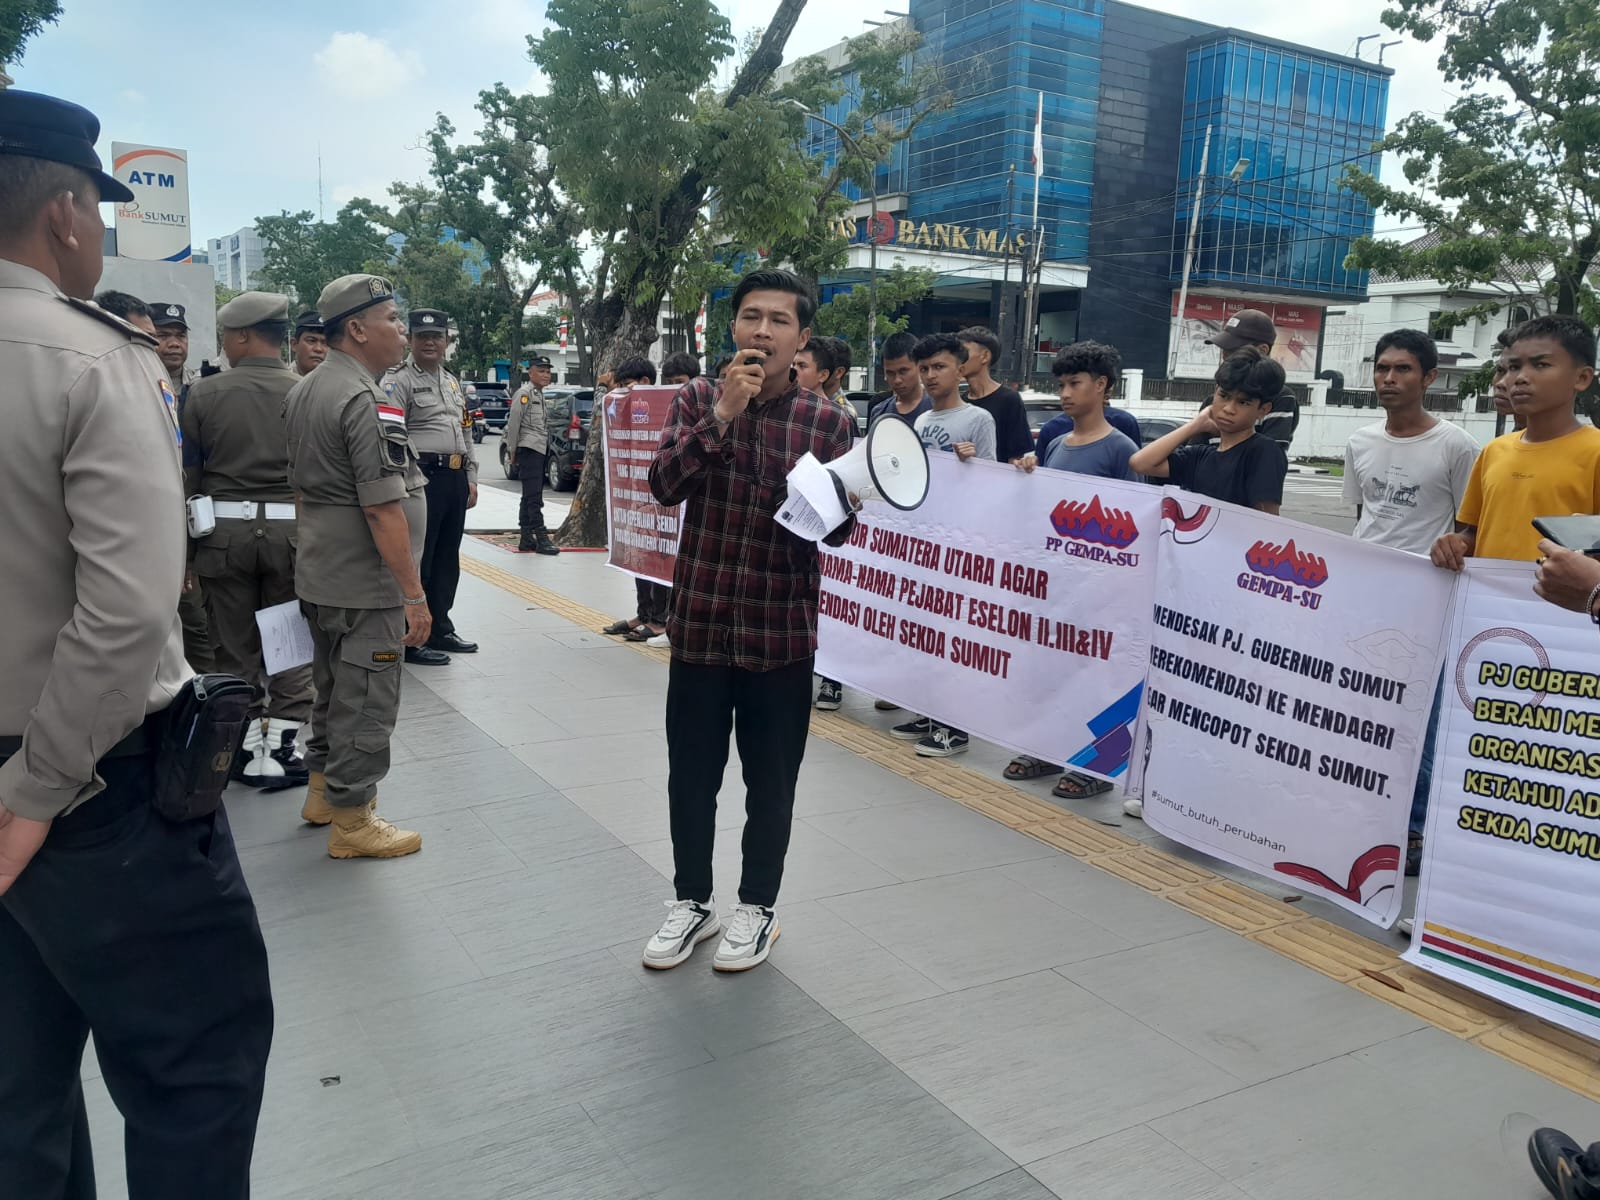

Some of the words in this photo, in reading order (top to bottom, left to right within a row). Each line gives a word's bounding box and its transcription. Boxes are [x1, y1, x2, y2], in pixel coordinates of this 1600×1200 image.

[128, 170, 175, 188] ATM
[898, 219, 970, 249] BANK
[870, 527, 942, 571] SUMATERA
[944, 547, 995, 587] UTARA
[1000, 561, 1049, 600] AGAR
[1045, 536, 1063, 552] PP
[1064, 541, 1139, 568] GEMPA-SU
[818, 551, 896, 599] NAMA-NAMA
[898, 577, 964, 620] PEJABAT
[967, 598, 1032, 641] ESELON
[1237, 572, 1322, 610] GEMPA-SU
[863, 606, 896, 640] OLEH
[899, 619, 945, 659] SEKDA
[950, 636, 1011, 680] SUMUT
[1153, 603, 1219, 645] MENDESAK
[1222, 628, 1244, 654] PJ.
[1251, 638, 1334, 684] GUBERNUR
[1338, 667, 1407, 704] SUMUT
[1479, 661, 1512, 687] PJ
[1266, 689, 1288, 716] KE
[1292, 698, 1395, 750] MENDAGRI
[1474, 697, 1562, 732] BERANI
[1563, 710, 1600, 739] ME
[1168, 698, 1251, 748] MENCOPOT
[1255, 733, 1311, 771] SEKDA
[1318, 755, 1391, 799] SUMUT.
[1469, 733, 1600, 779] ORGANISAS
[1464, 769, 1564, 811] KETAHUI
[1152, 790, 1286, 853] #sumut_butuh_perubahan
[1458, 805, 1531, 844] SEKDA
[1533, 823, 1600, 861] SUMU
